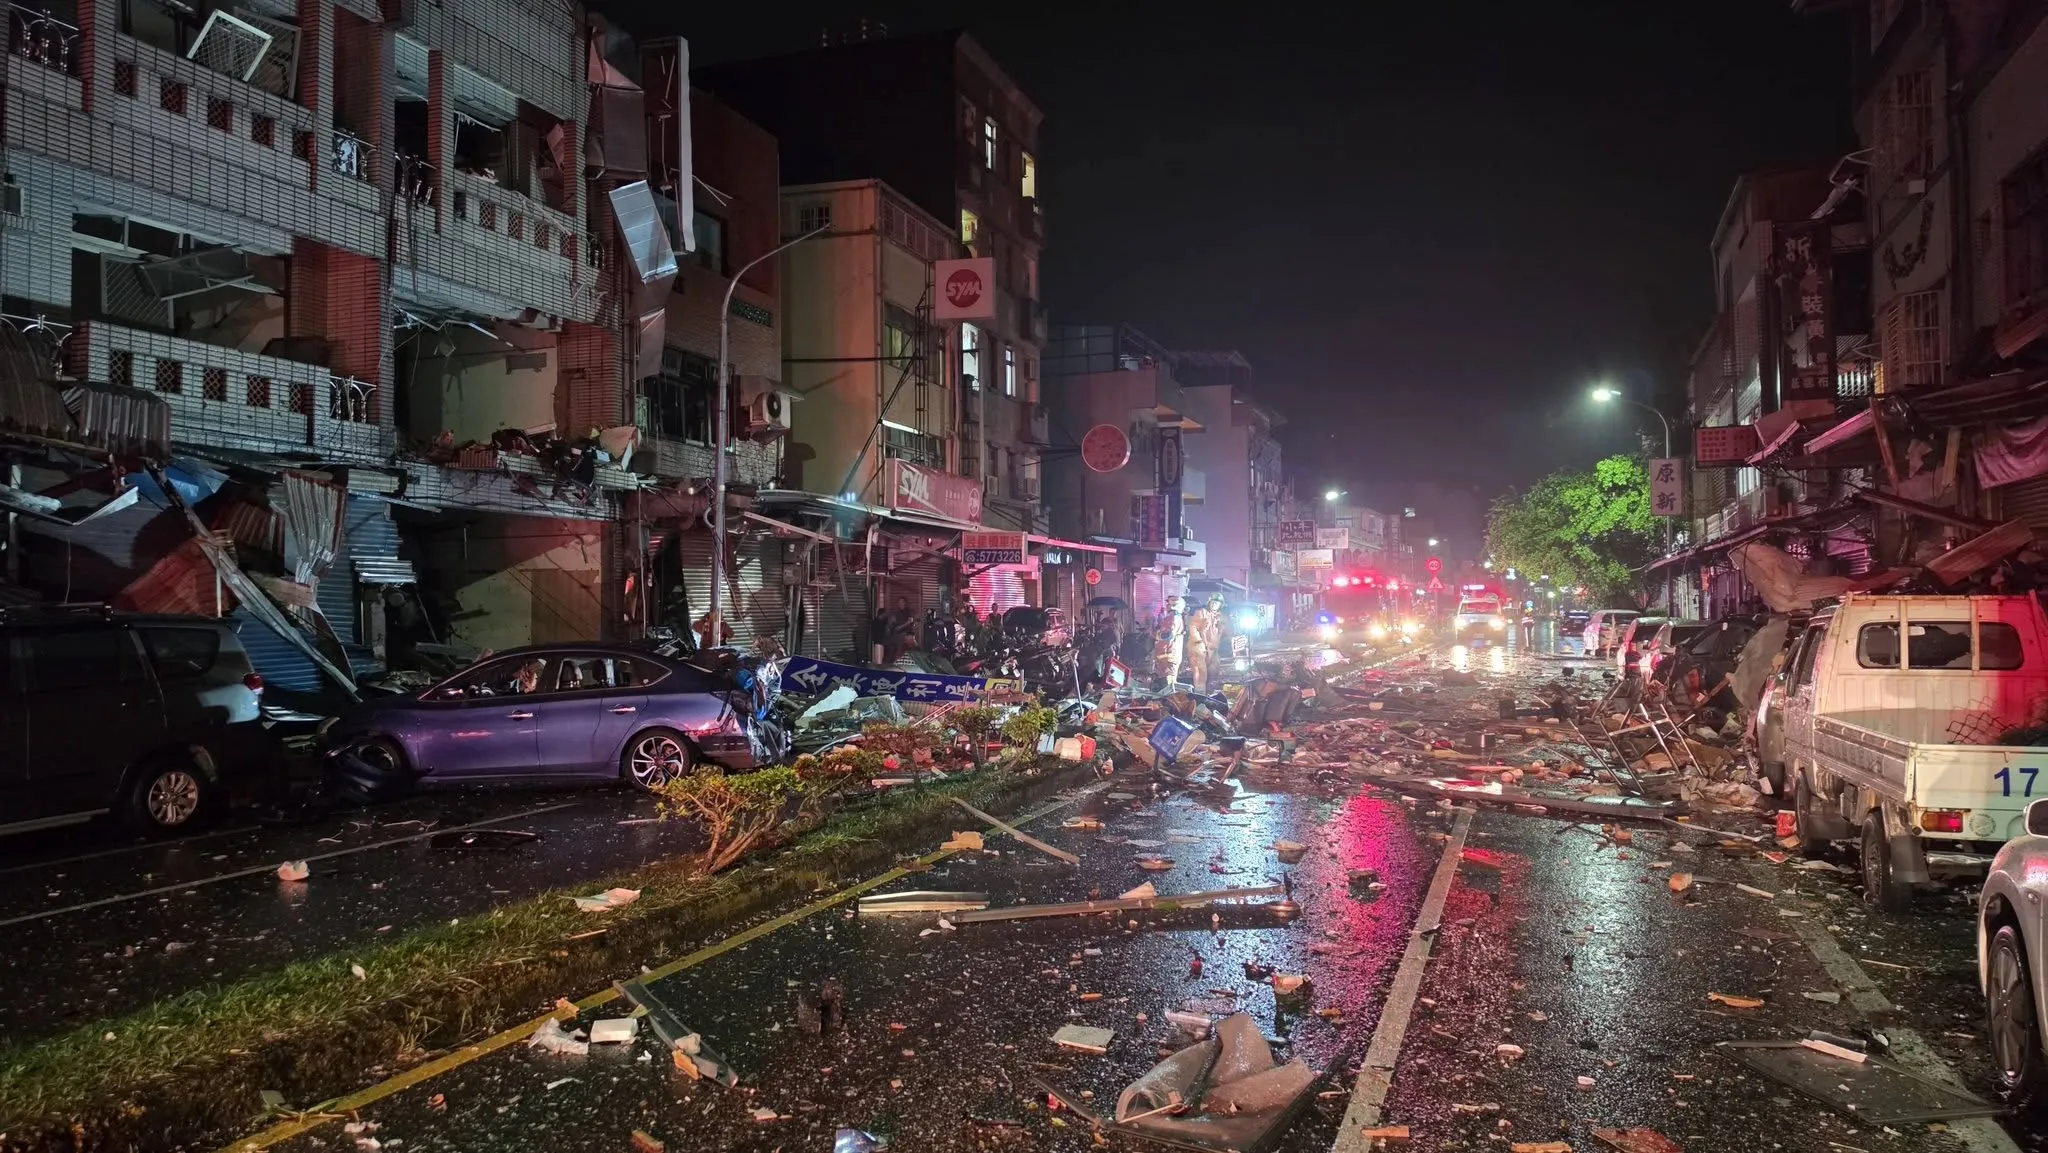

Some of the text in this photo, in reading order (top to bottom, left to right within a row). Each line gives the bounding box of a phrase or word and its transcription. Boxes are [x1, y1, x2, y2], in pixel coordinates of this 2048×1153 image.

[946, 281, 981, 300] SYM
[899, 469, 930, 504] SYM
[1656, 463, 1677, 511] 原新
[1994, 767, 2039, 797] 17
